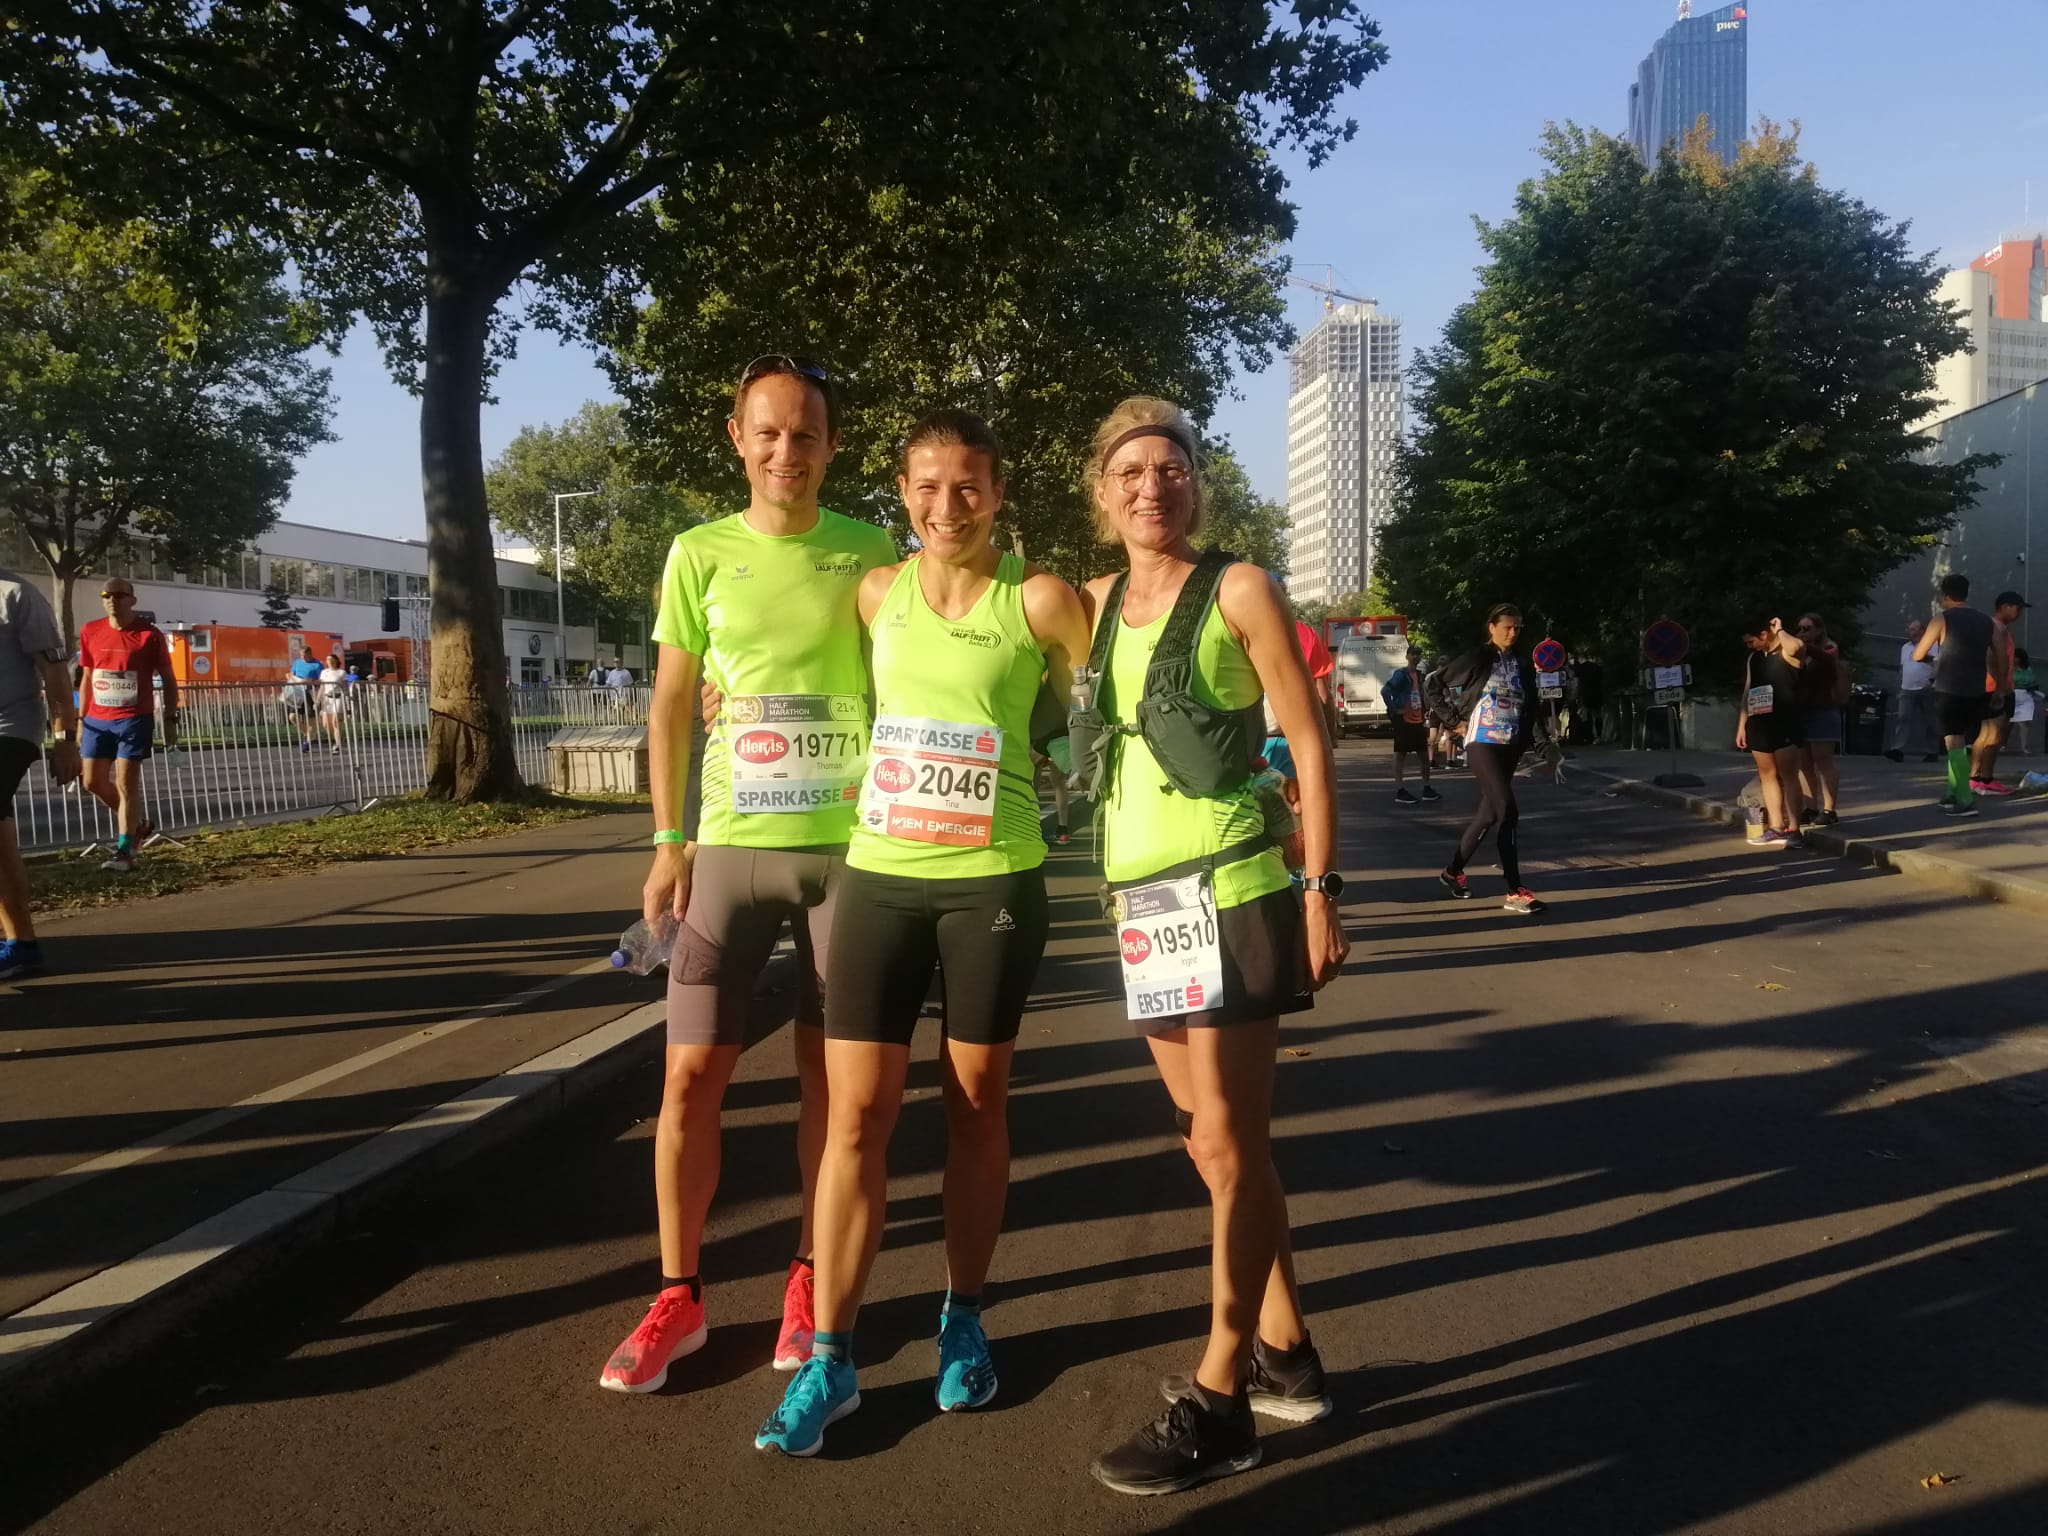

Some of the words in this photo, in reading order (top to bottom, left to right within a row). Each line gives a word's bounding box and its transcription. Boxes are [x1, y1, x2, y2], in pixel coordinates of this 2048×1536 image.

[1716, 20, 1740, 32] pwc
[1659, 690, 1680, 701] Ende
[769, 708, 810, 716] MARATHON
[740, 738, 785, 756] Hervis
[793, 732, 861, 758] 19771
[876, 724, 974, 750] SPARKASSE
[816, 762, 843, 770] Thomas
[876, 764, 911, 787] Hervis
[917, 763, 992, 801] 2046
[737, 788, 841, 807] SPARKASSE
[945, 800, 960, 809] Tina
[926, 820, 986, 837] ENERGIE
[1131, 895, 1145, 904] HALF
[1131, 900, 1160, 912] MARATHON
[1153, 917, 1215, 955] 19510
[1122, 937, 1149, 957] Hervis
[1180, 956, 1198, 967] Ingrid
[1136, 987, 1185, 1015] ERSTE
